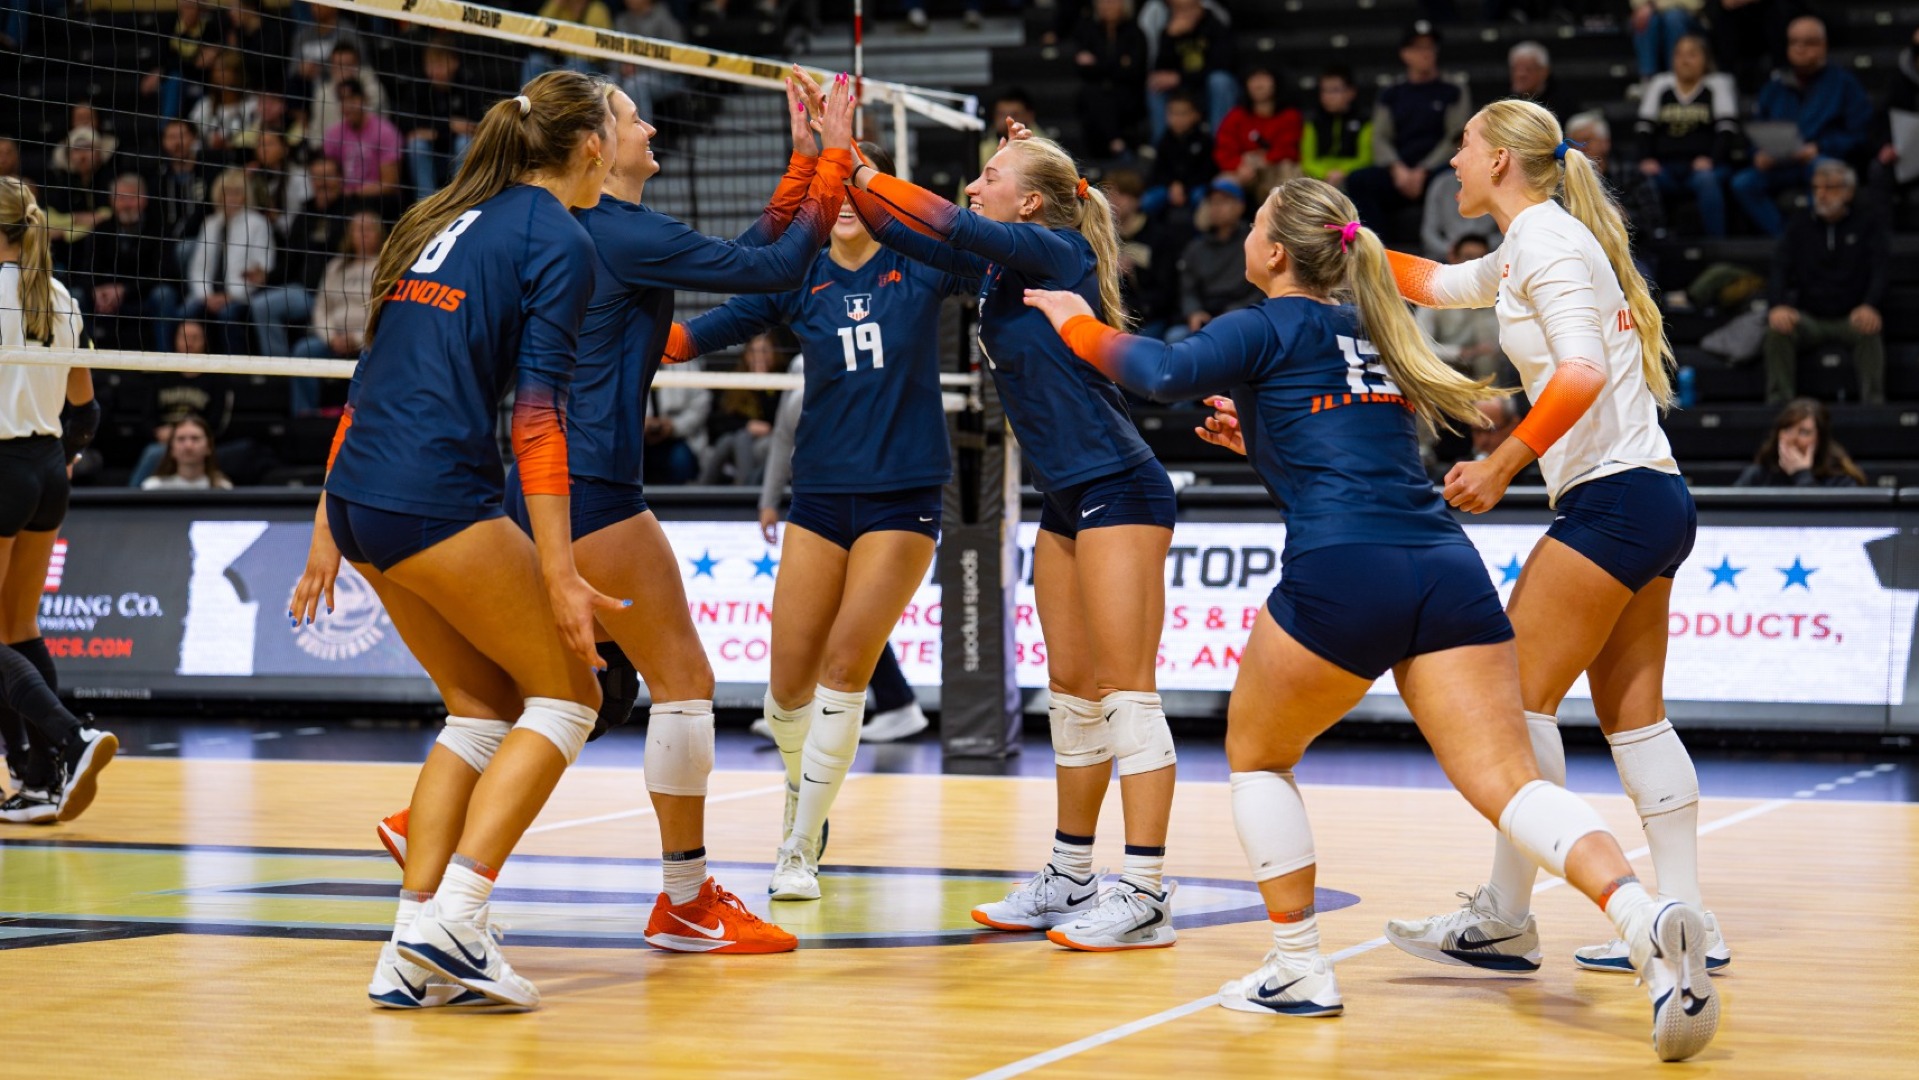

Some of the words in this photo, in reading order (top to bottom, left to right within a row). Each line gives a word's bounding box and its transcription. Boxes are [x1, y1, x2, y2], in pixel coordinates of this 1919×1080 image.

[410, 210, 482, 274] 8
[384, 279, 467, 312] LINOIS
[837, 322, 884, 372] 19
[960, 549, 979, 604] sports
[1668, 613, 1843, 642] ODUCTS,
